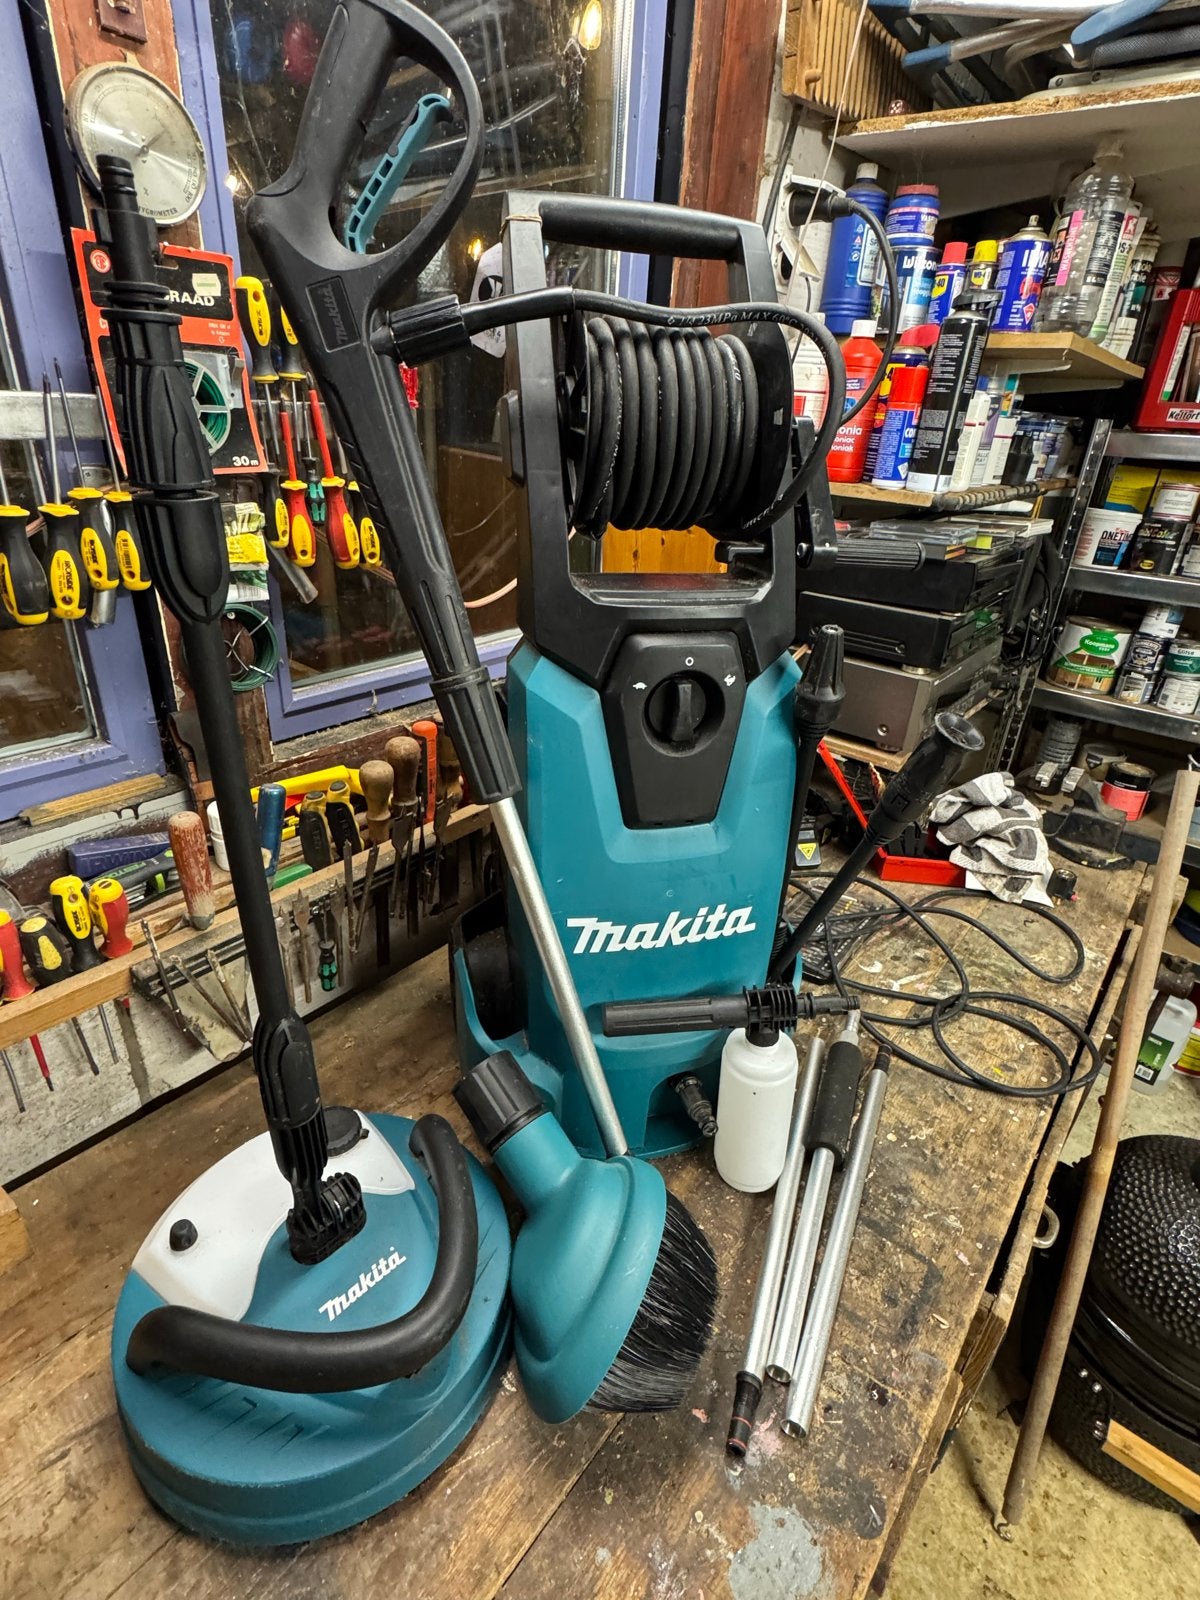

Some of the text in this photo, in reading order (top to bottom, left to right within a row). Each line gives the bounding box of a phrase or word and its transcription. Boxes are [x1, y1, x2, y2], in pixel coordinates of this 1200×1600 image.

[164, 289, 216, 307] RAAD
[319, 283, 349, 345] Makita
[741, 310, 770, 321] MAX
[232, 455, 260, 467] 30 m
[567, 903, 757, 954] Makita
[318, 1251, 407, 1322] Makita
